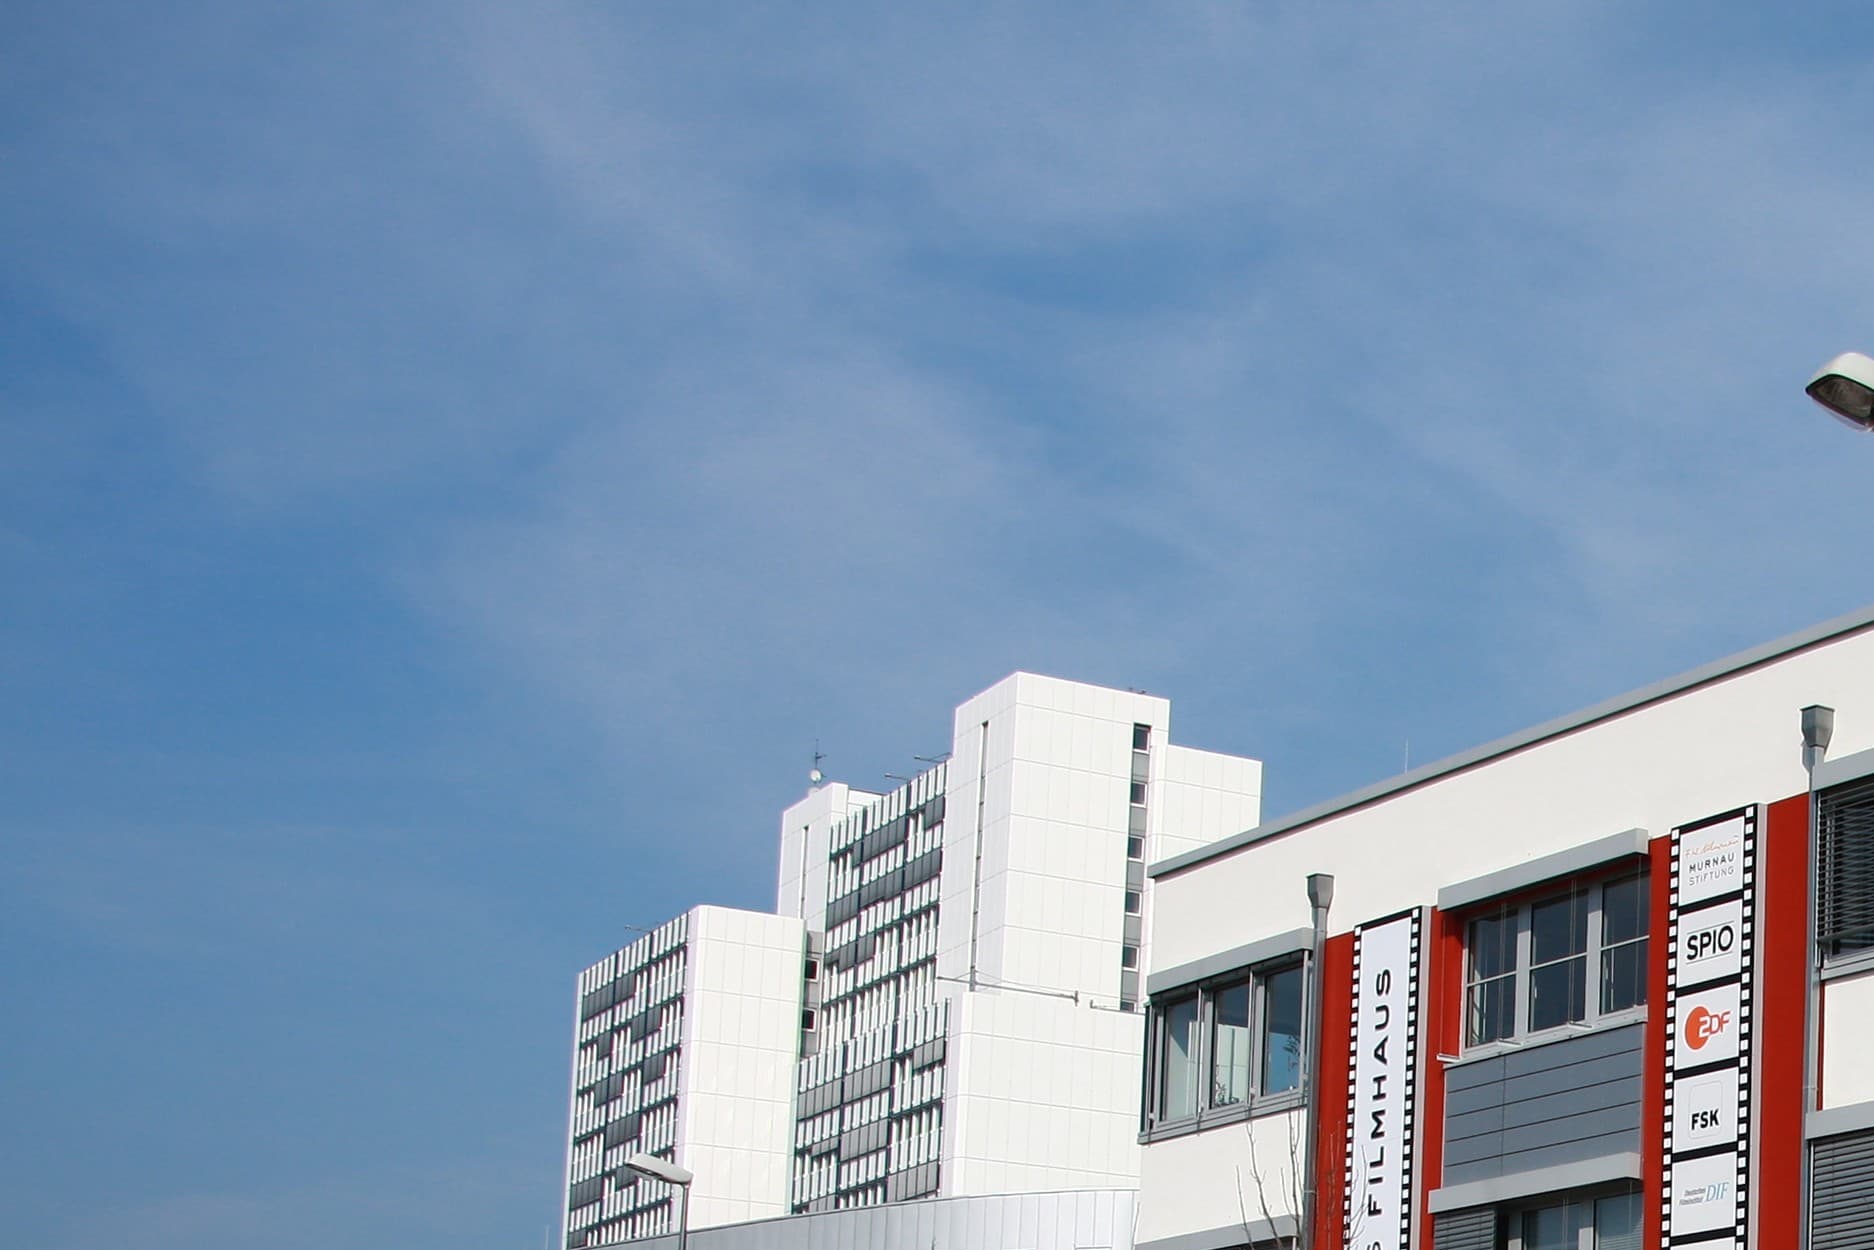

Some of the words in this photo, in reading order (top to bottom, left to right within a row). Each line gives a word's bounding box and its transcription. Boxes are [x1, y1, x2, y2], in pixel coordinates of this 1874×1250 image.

[1689, 852, 1735, 873] MURNAU
[1689, 866, 1735, 886] STIFTUNG
[1687, 925, 1734, 960] SPIO
[1698, 1011, 1731, 1037] ZDF
[1367, 968, 1391, 1217] FILMHAUS
[1691, 1108, 1720, 1130] FSK
[1705, 1182, 1729, 1202] DIF
